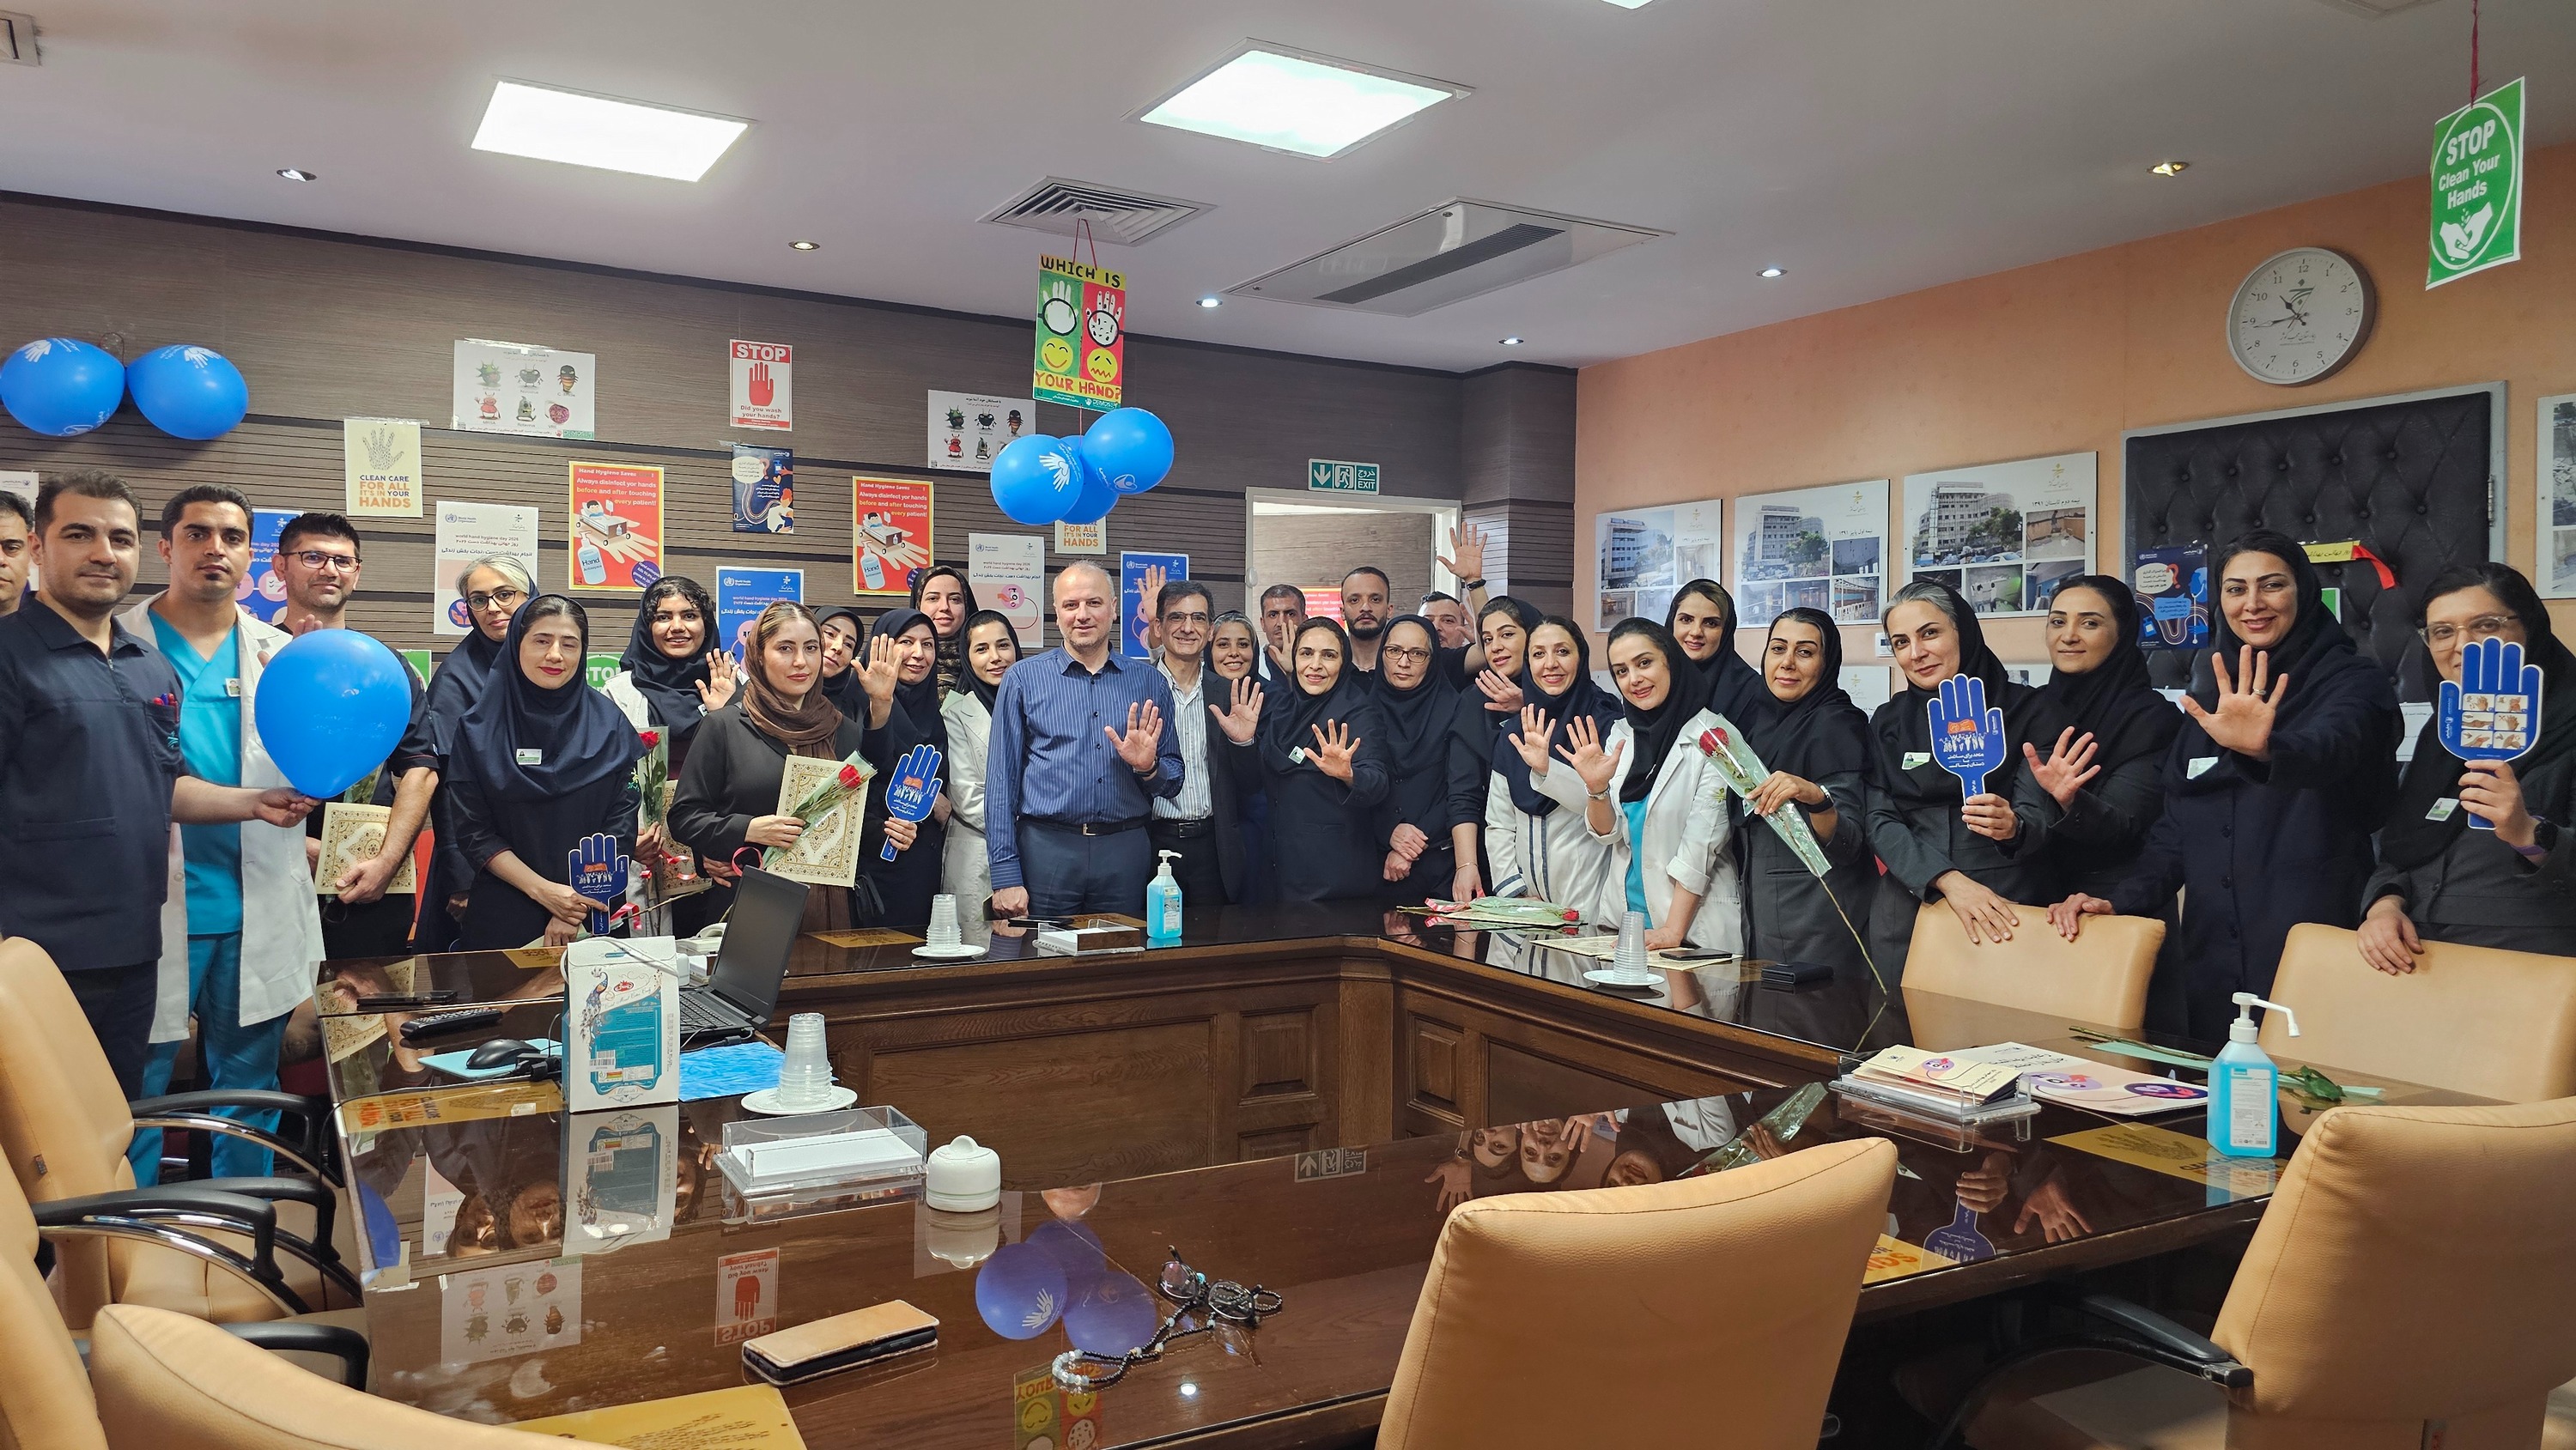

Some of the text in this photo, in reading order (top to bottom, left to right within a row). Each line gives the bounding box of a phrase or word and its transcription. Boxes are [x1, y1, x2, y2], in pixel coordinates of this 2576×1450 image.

[2446, 119, 2496, 166] STOP
[2439, 154, 2500, 191] Clean Your
[2447, 180, 2488, 210] Hands
[1041, 256, 1121, 288] WHICH IS
[2298, 265, 2309, 273] 12
[2273, 276, 2282, 285] 11
[2341, 285, 2348, 293] 2
[2257, 293, 2268, 301] 10
[737, 344, 786, 361] STOP
[1035, 370, 1074, 391] YOUR
[1079, 381, 1121, 400] HAND?
[1358, 468, 1375, 478] خروج
[360, 482, 410, 491] FOR ALL
[1358, 481, 1375, 489] EXIT
[629, 489, 656, 497] touching
[359, 497, 411, 508] HANDS
[1064, 538, 1099, 547] HANDS
[582, 557, 600, 566] Hand
[864, 565, 879, 573] Hand
